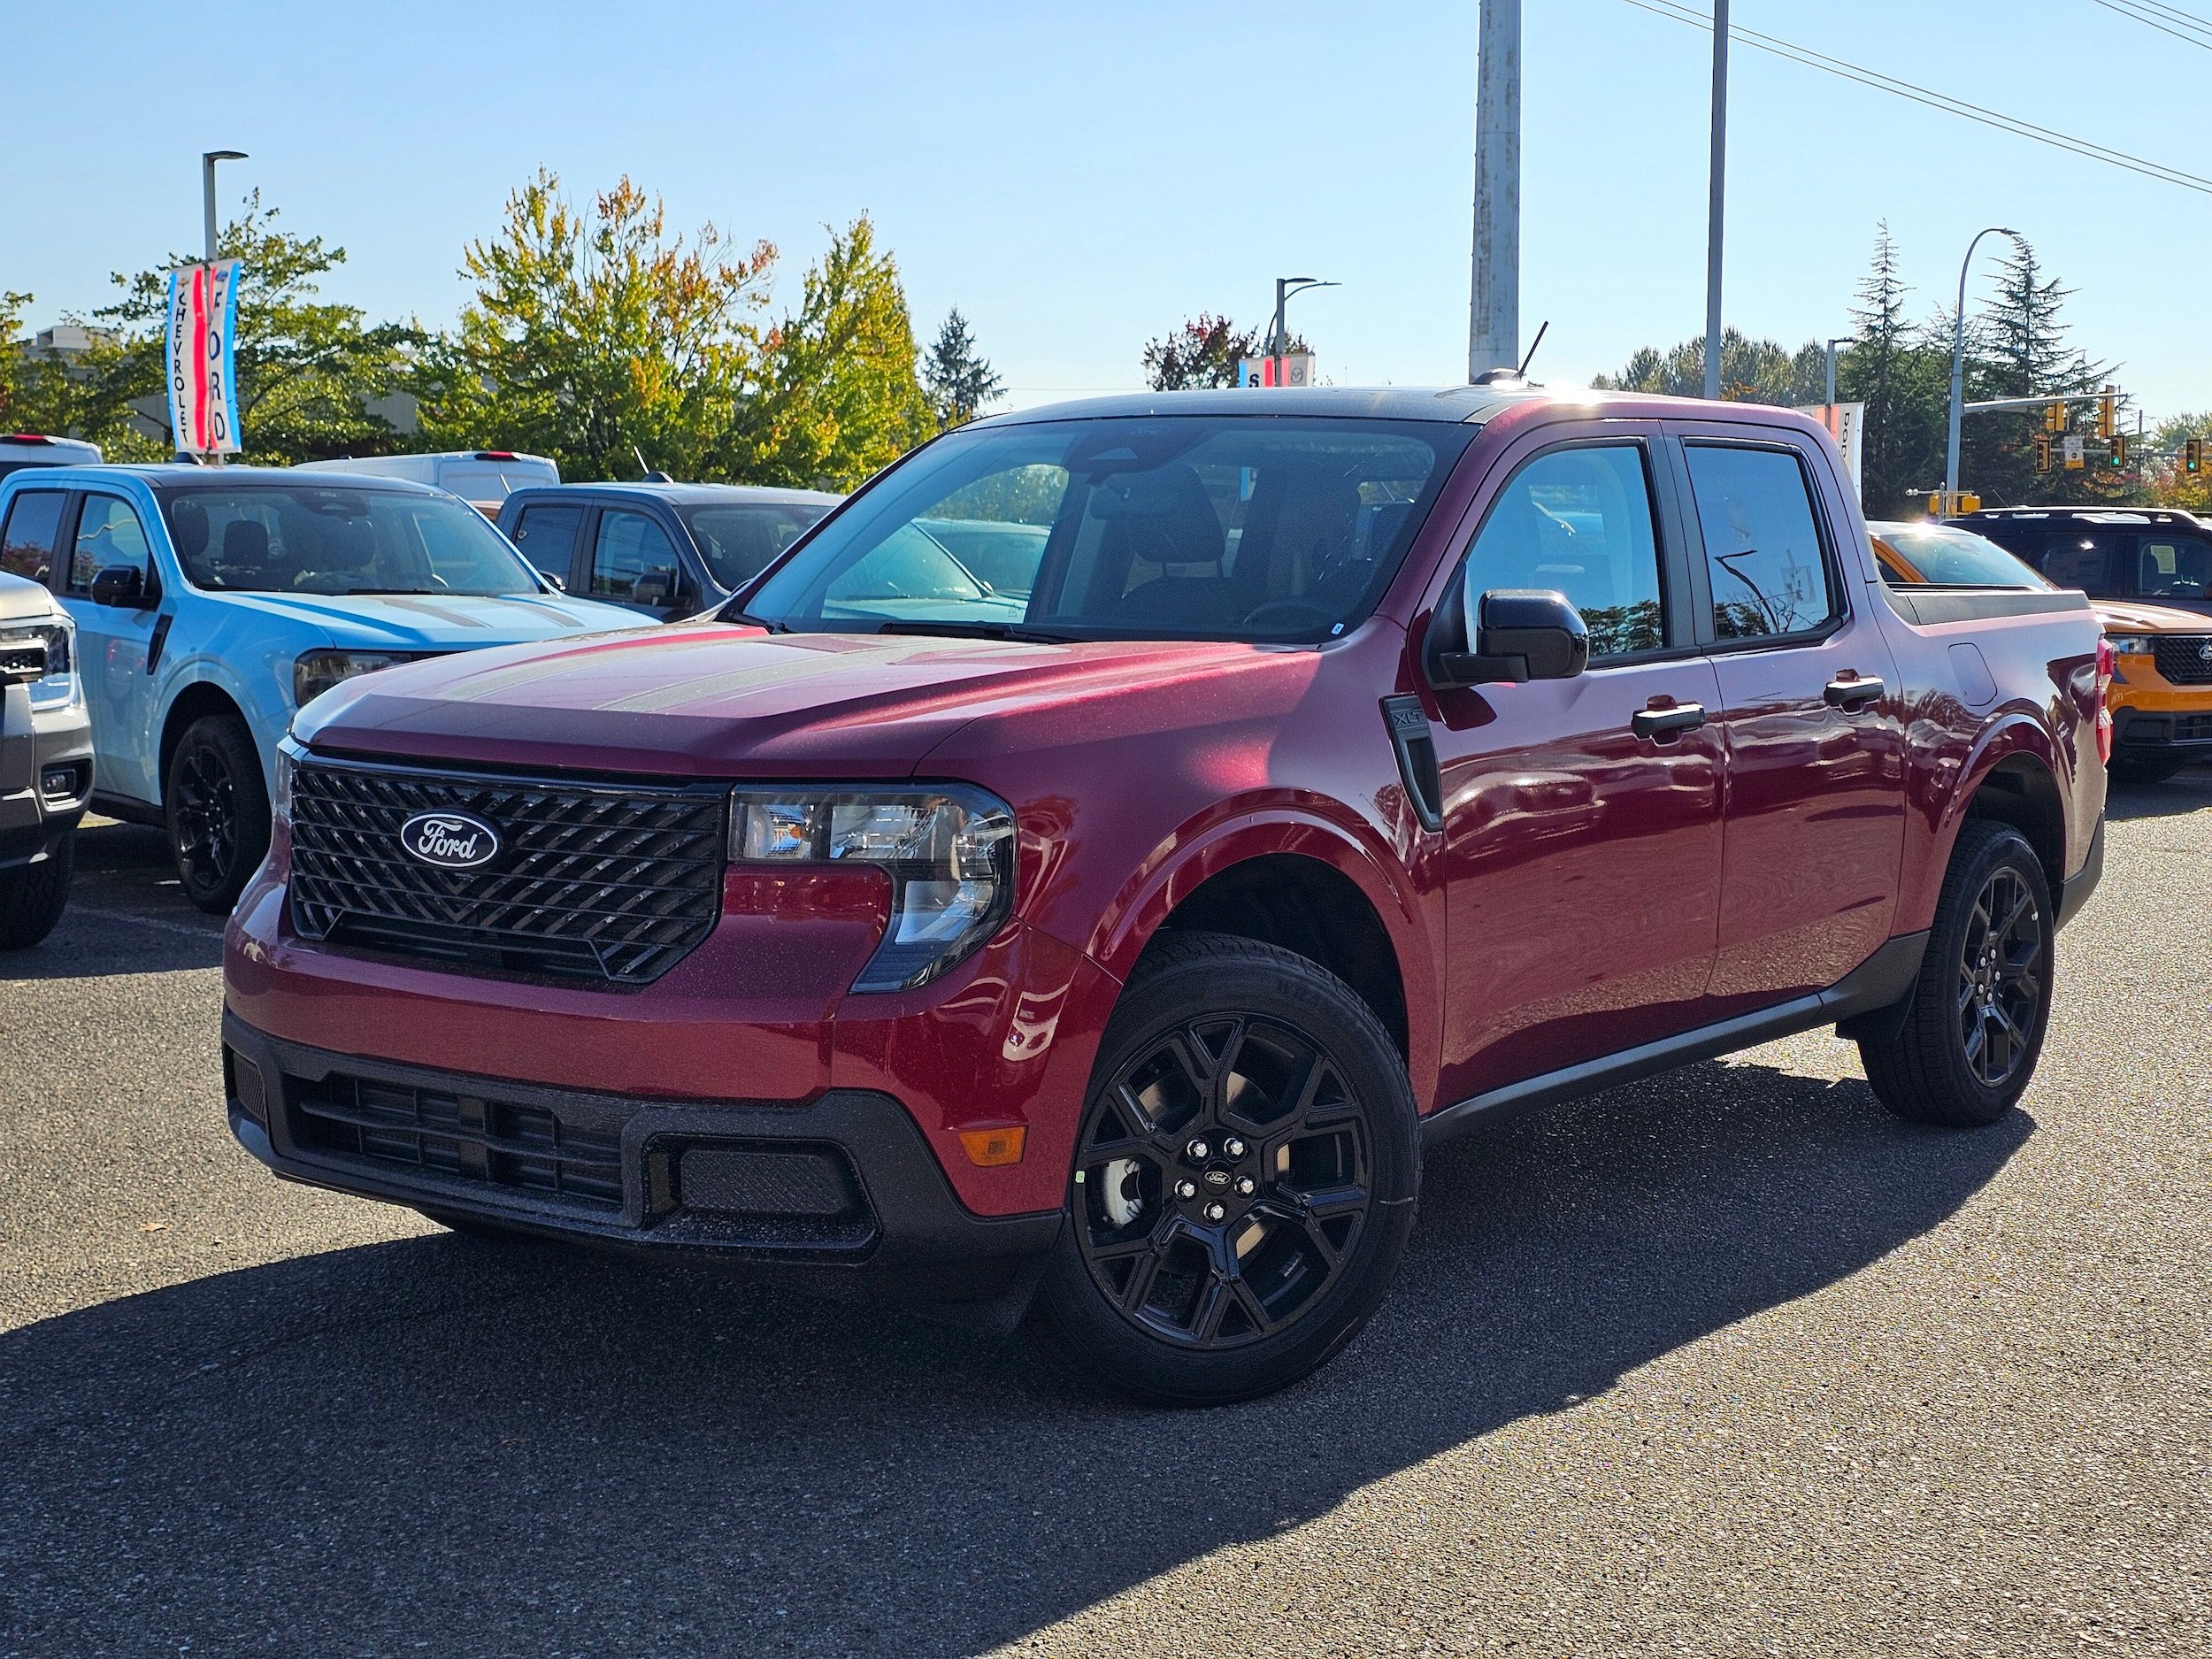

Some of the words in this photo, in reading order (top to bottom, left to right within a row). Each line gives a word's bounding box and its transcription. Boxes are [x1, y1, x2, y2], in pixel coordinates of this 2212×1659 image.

[173, 292, 188, 442] CHEVROLET
[208, 290, 225, 441] FORD
[1394, 710, 1423, 726] XLT
[418, 819, 477, 859] Ford
[1209, 1173, 1226, 1183] Ford
